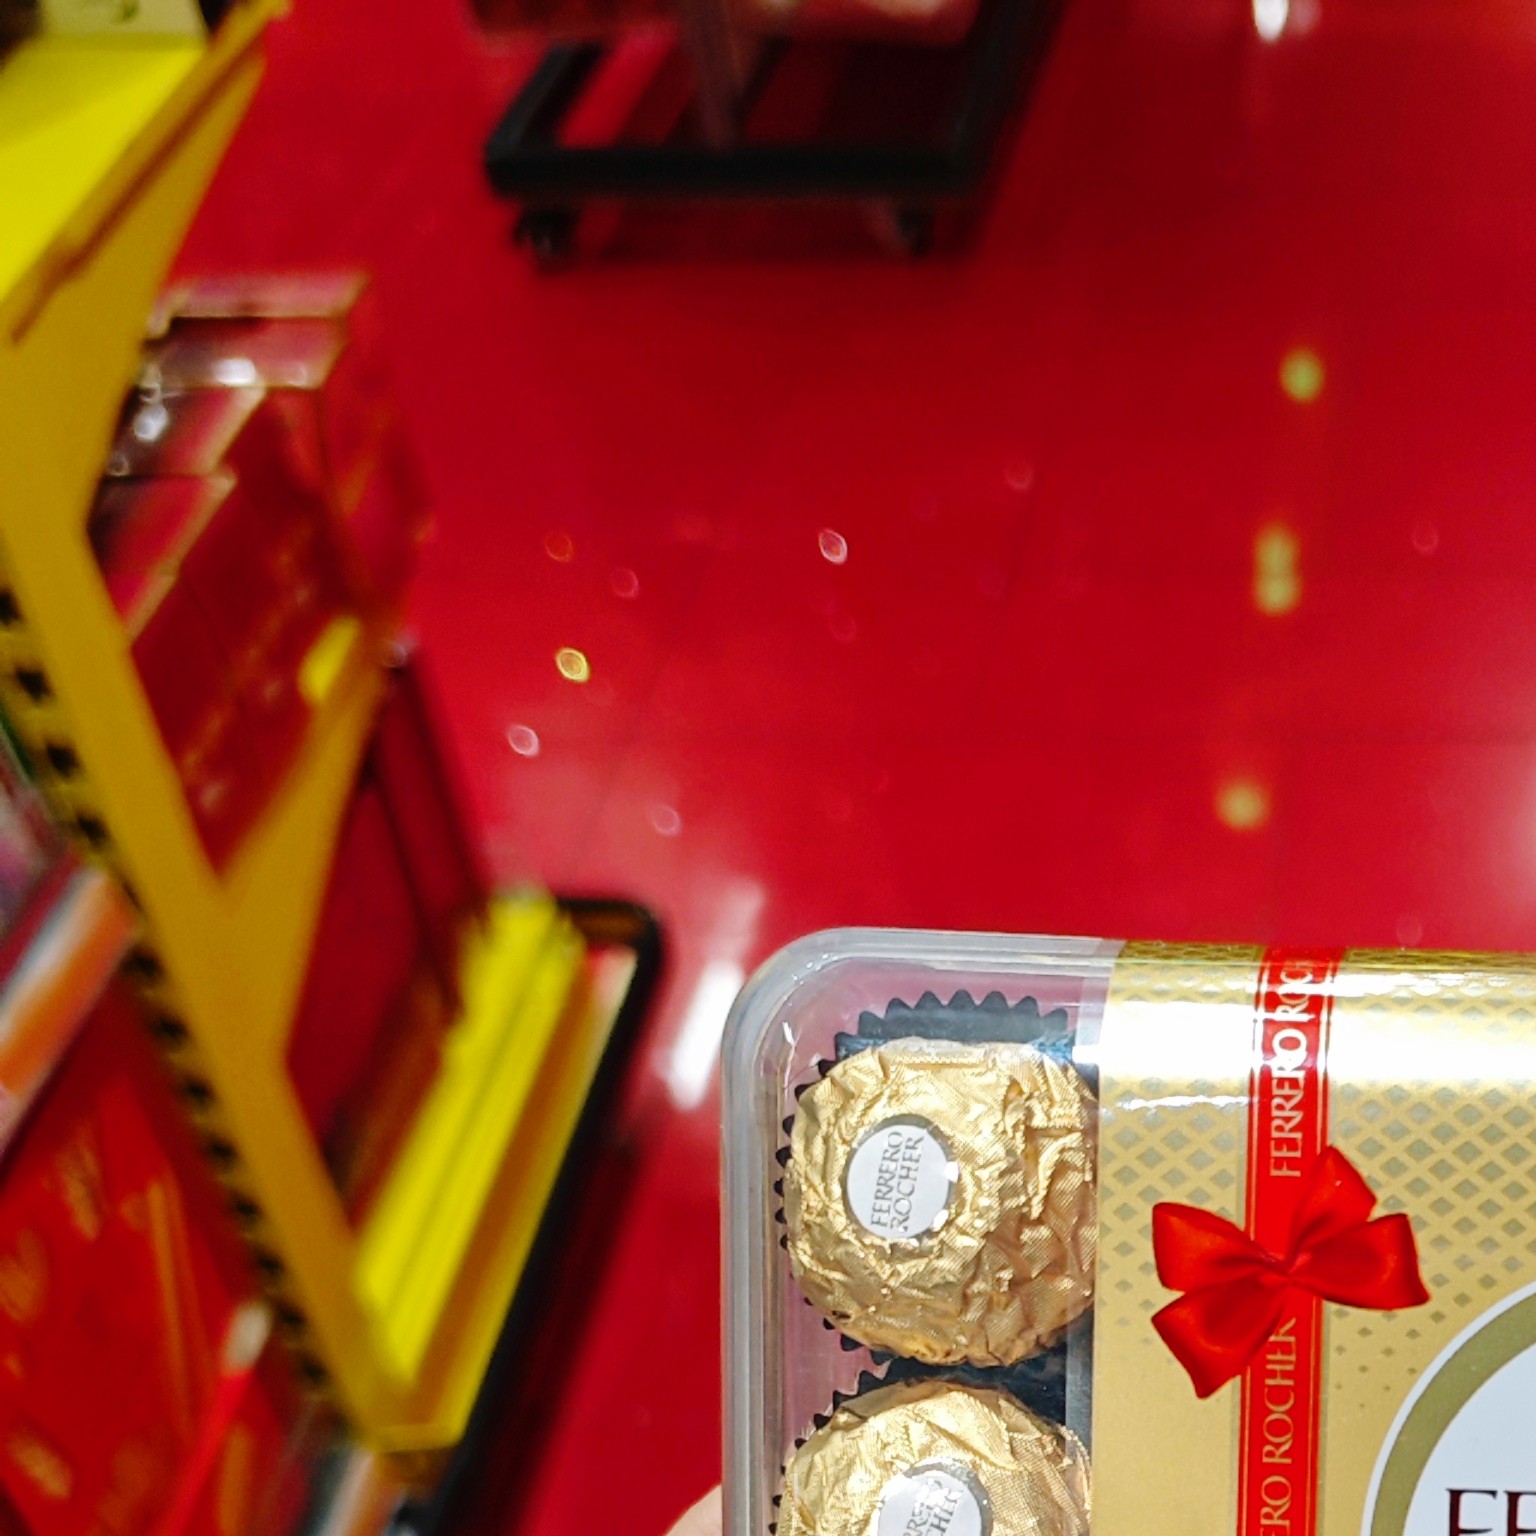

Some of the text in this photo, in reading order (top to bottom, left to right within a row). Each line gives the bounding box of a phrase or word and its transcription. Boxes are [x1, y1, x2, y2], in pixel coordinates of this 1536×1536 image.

[870, 1130, 904, 1228] FERRERO
[890, 1135, 925, 1232] ROCHER
[1261, 1316, 1298, 1464] ROCHER
